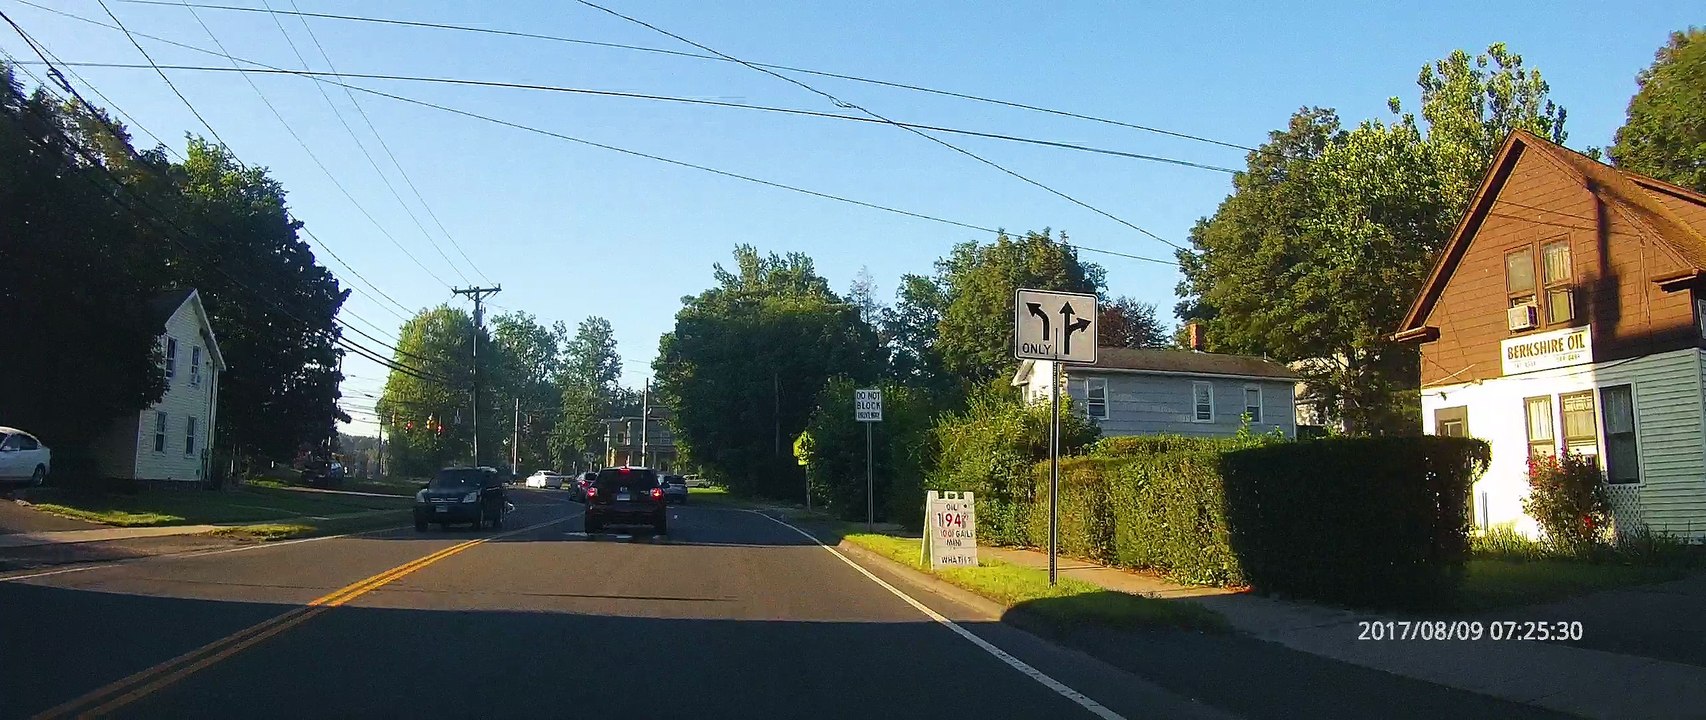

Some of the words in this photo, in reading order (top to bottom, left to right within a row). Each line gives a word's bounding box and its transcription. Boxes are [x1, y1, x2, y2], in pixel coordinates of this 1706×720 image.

[1022, 343, 1052, 355] ONLY
[1507, 338, 1564, 359] BERKSHIRE
[1567, 334, 1585, 350] OIL
[857, 391, 866, 400] DO
[867, 391, 880, 400] NOT
[857, 401, 880, 410] BLOCK
